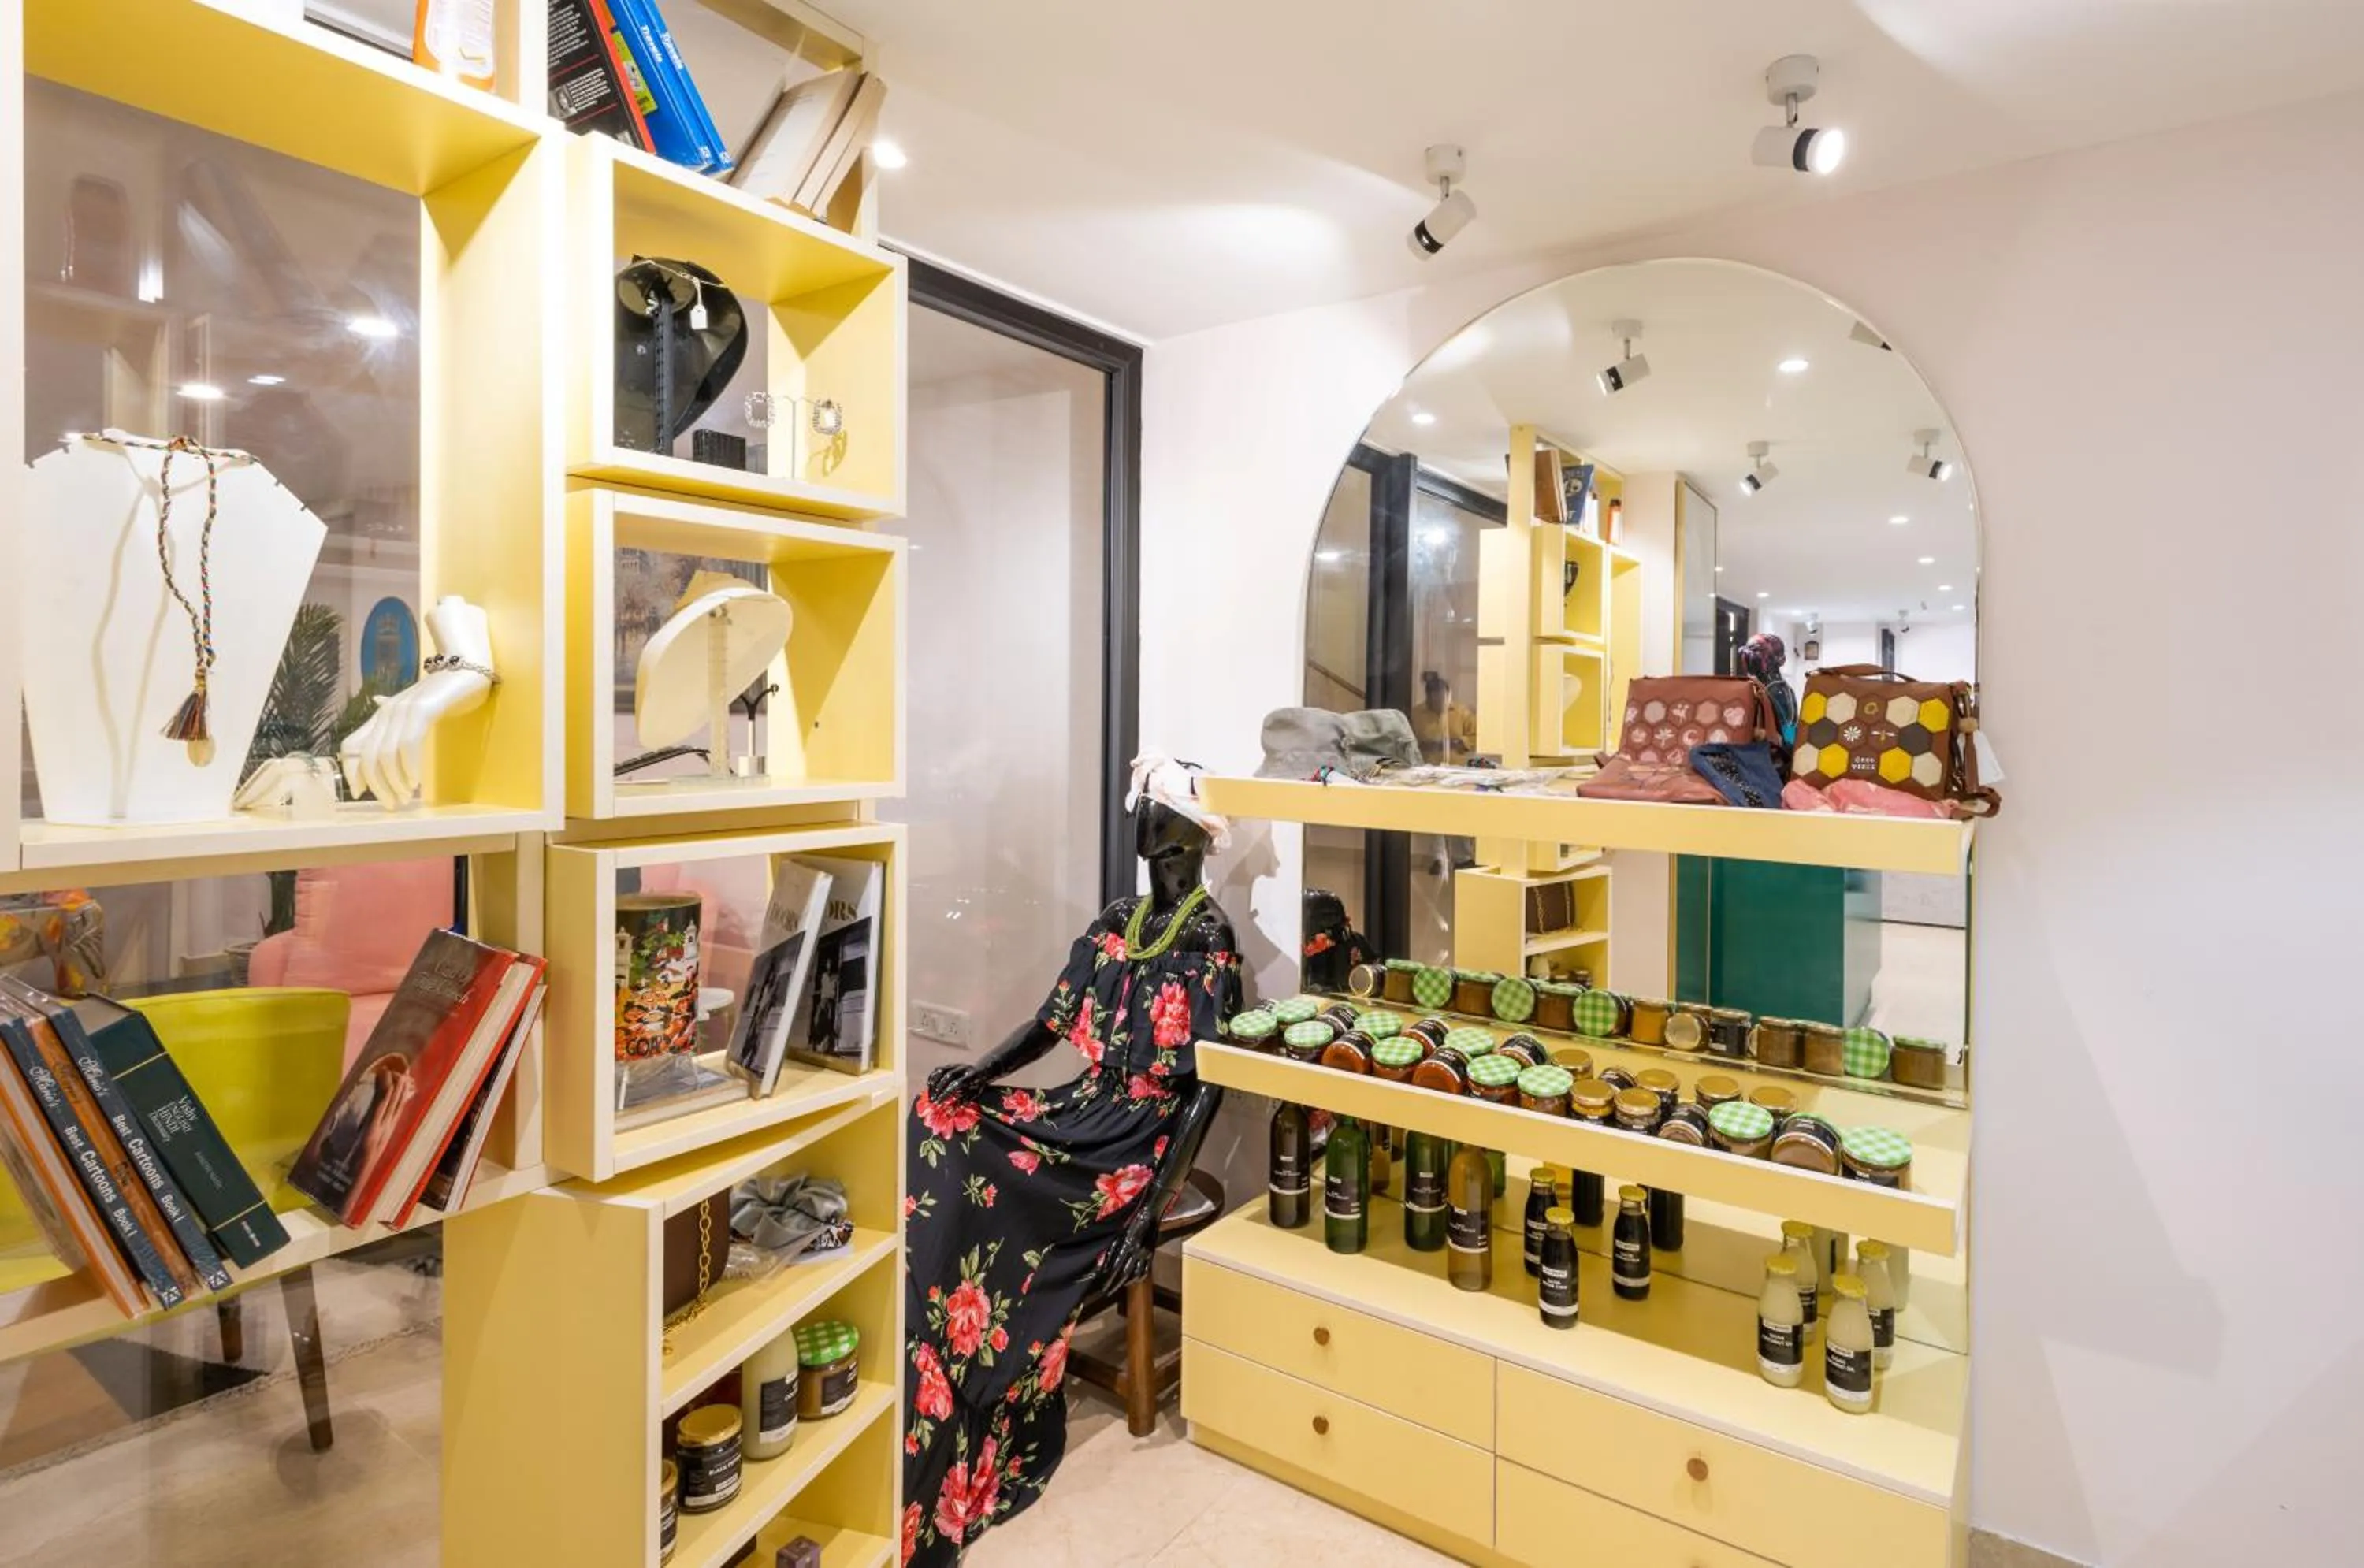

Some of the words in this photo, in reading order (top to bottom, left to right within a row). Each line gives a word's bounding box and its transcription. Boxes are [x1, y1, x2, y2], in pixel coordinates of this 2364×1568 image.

[65, 1125, 84, 1148] Best
[80, 1150, 117, 1203] Cartoons
[113, 1208, 132, 1232] Book
[113, 1115, 133, 1138] Best
[128, 1139, 164, 1190] Cartoons
[161, 1194, 180, 1219] Book
